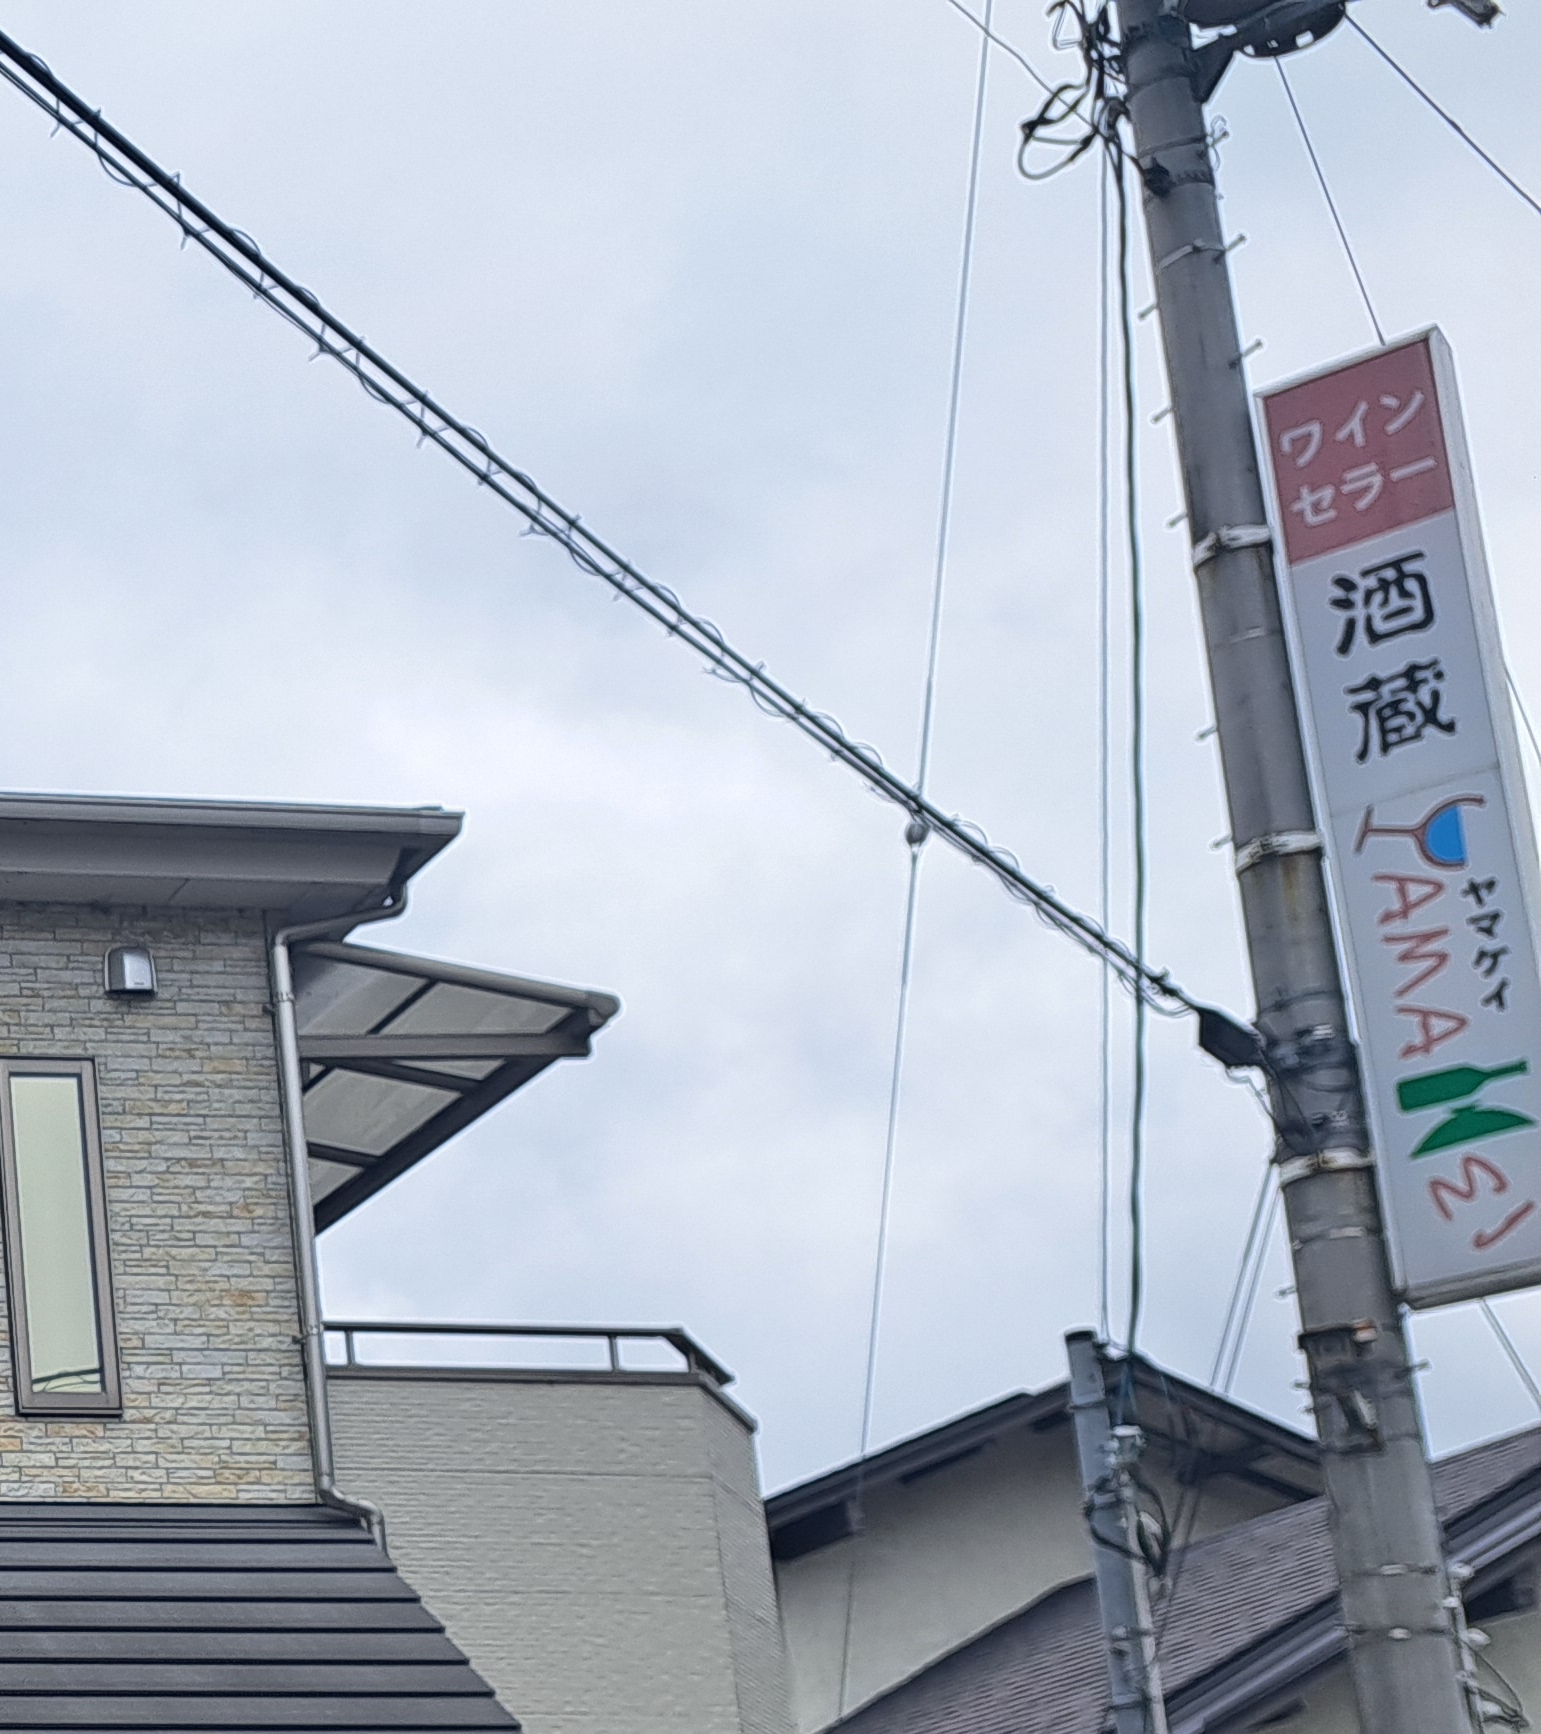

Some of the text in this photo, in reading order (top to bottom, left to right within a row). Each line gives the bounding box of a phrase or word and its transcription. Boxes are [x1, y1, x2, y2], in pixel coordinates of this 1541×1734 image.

[1279, 391, 1425, 468] ワイン
[1291, 456, 1438, 527] セラー
[1328, 550, 1457, 765] 酒蔵
